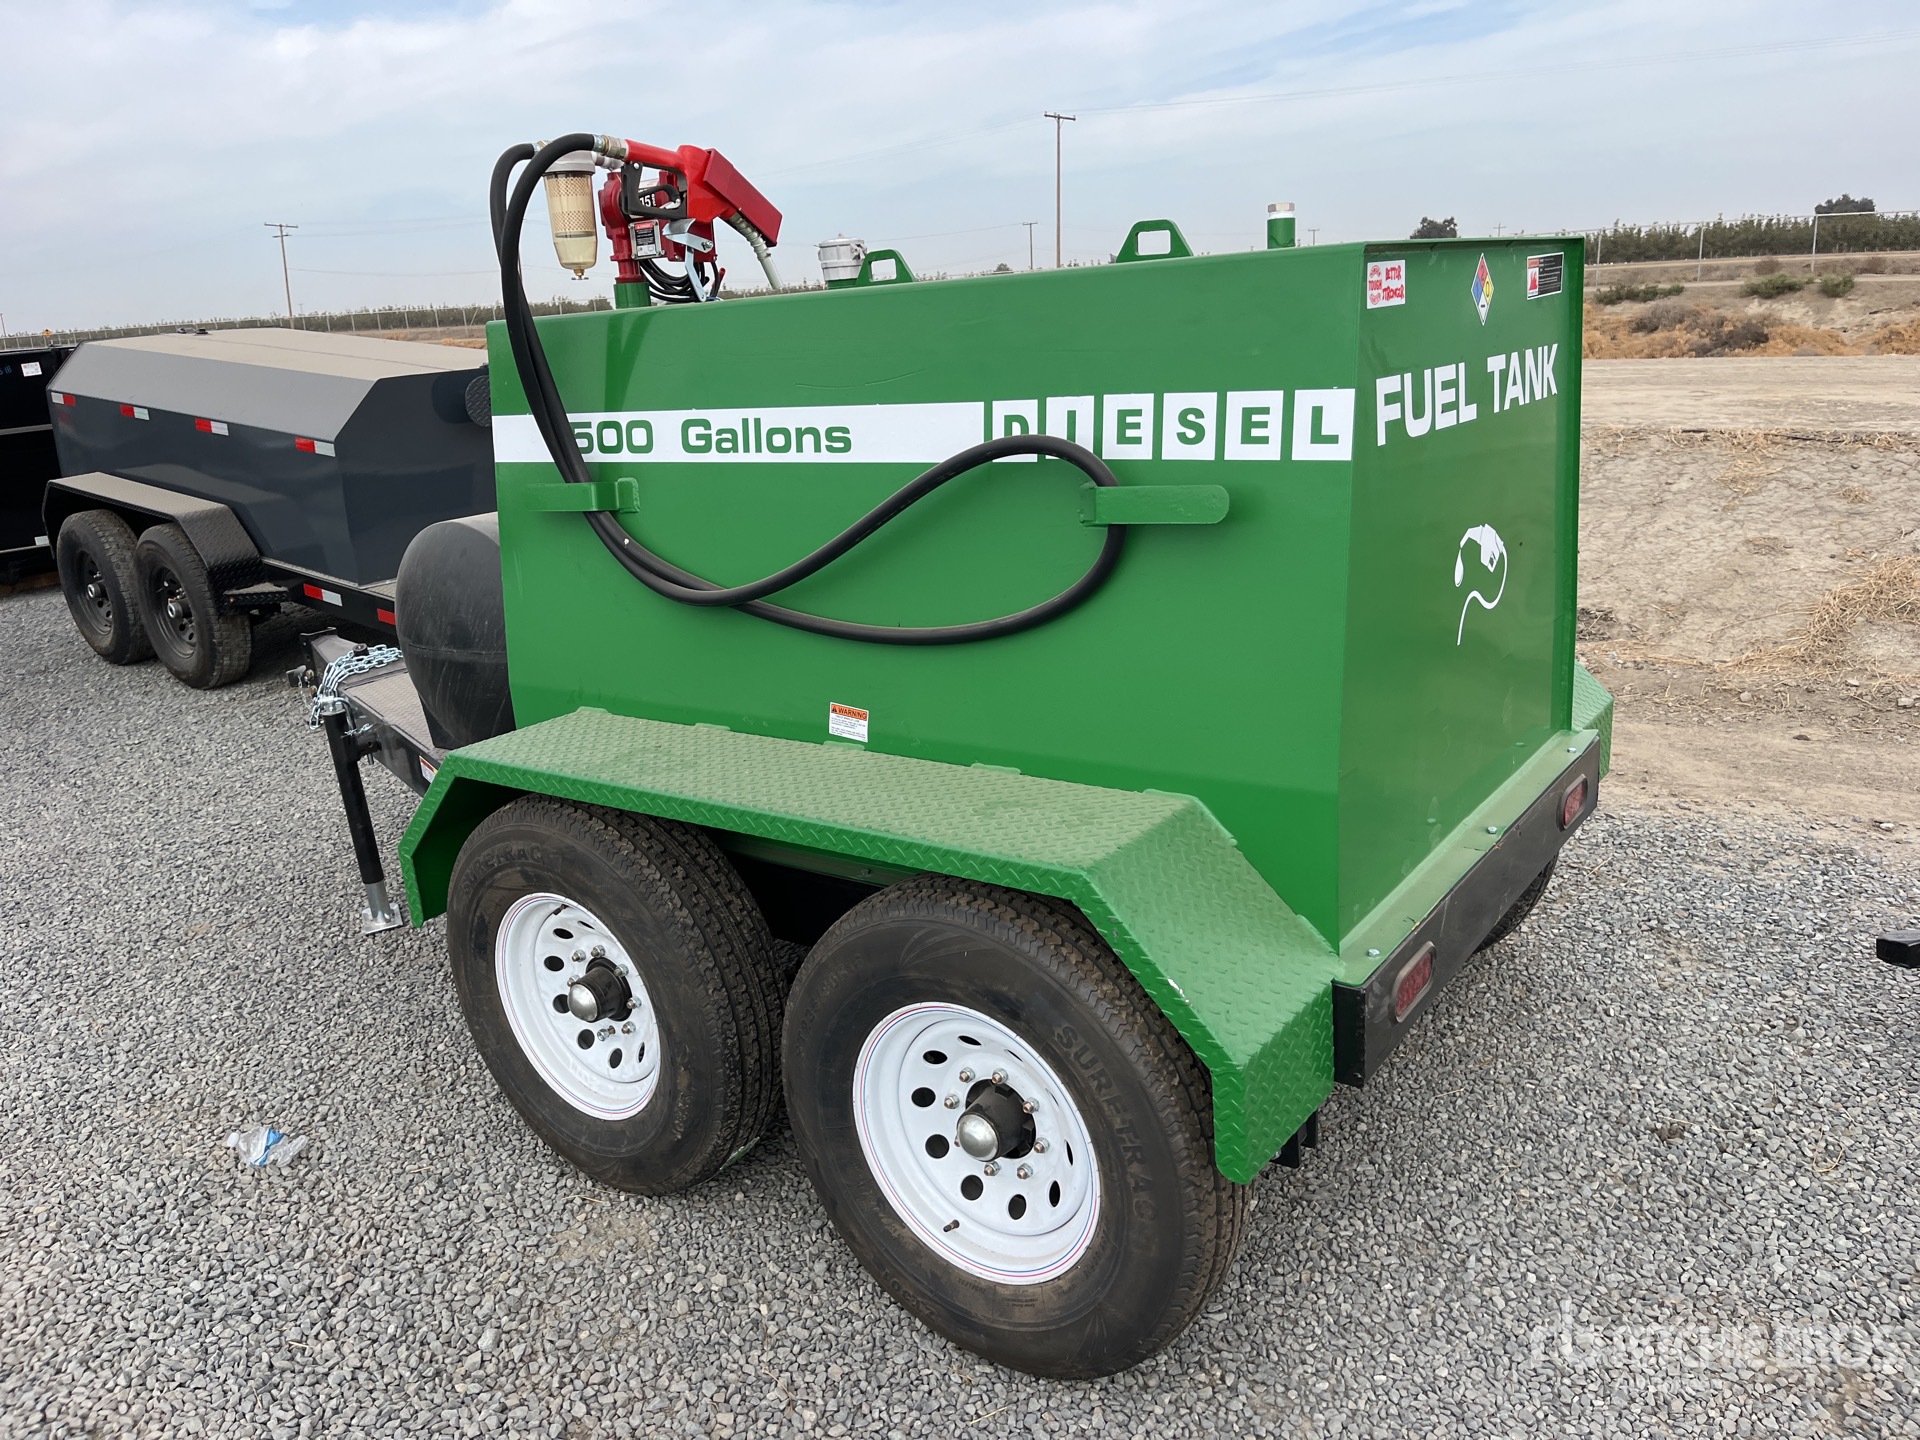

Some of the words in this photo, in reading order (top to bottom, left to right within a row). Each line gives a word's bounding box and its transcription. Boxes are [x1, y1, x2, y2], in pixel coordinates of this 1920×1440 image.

[1376, 362, 1477, 446] FUEL
[1487, 343, 1558, 413] TANK
[570, 420, 654, 455] 500
[681, 417, 853, 455] Gallons
[1003, 405, 1339, 446] DIESEL
[838, 706, 867, 720] WARNING
[1055, 1025, 1158, 1221] SURETRAC
